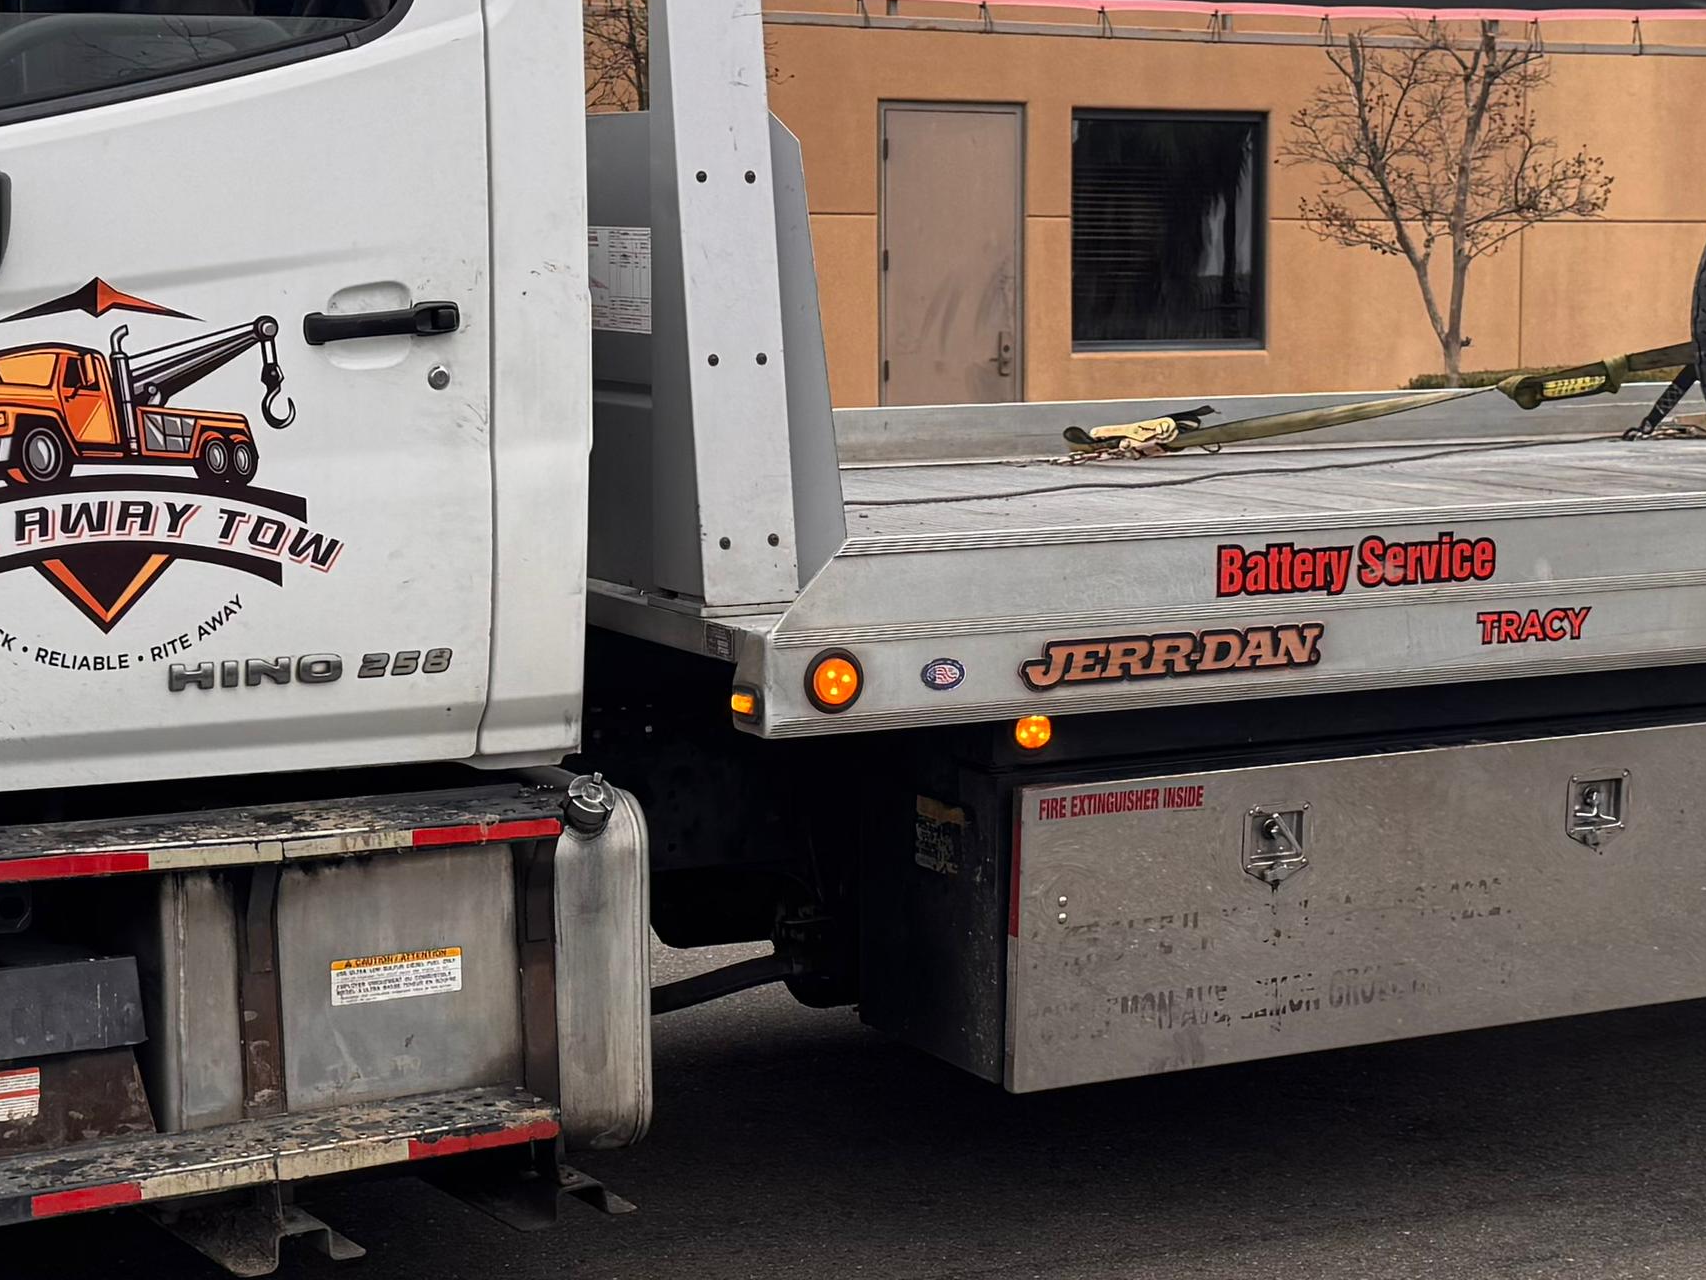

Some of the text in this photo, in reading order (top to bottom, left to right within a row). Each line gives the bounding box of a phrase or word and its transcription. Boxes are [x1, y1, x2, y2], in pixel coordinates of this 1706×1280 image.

[14, 500, 199, 544] AWAY
[219, 506, 345, 572] TOW
[1217, 532, 1496, 596] Battery Service
[35, 647, 130, 671] RELIABLE
[150, 632, 192, 662] RITE
[197, 593, 244, 643] AWAY
[1022, 624, 1322, 690] JERR-DAN
[1477, 607, 1591, 646] TRACY
[168, 647, 453, 692] HINO 258
[1039, 786, 1204, 820] FIRE EXTINGUISHER INSIDE
